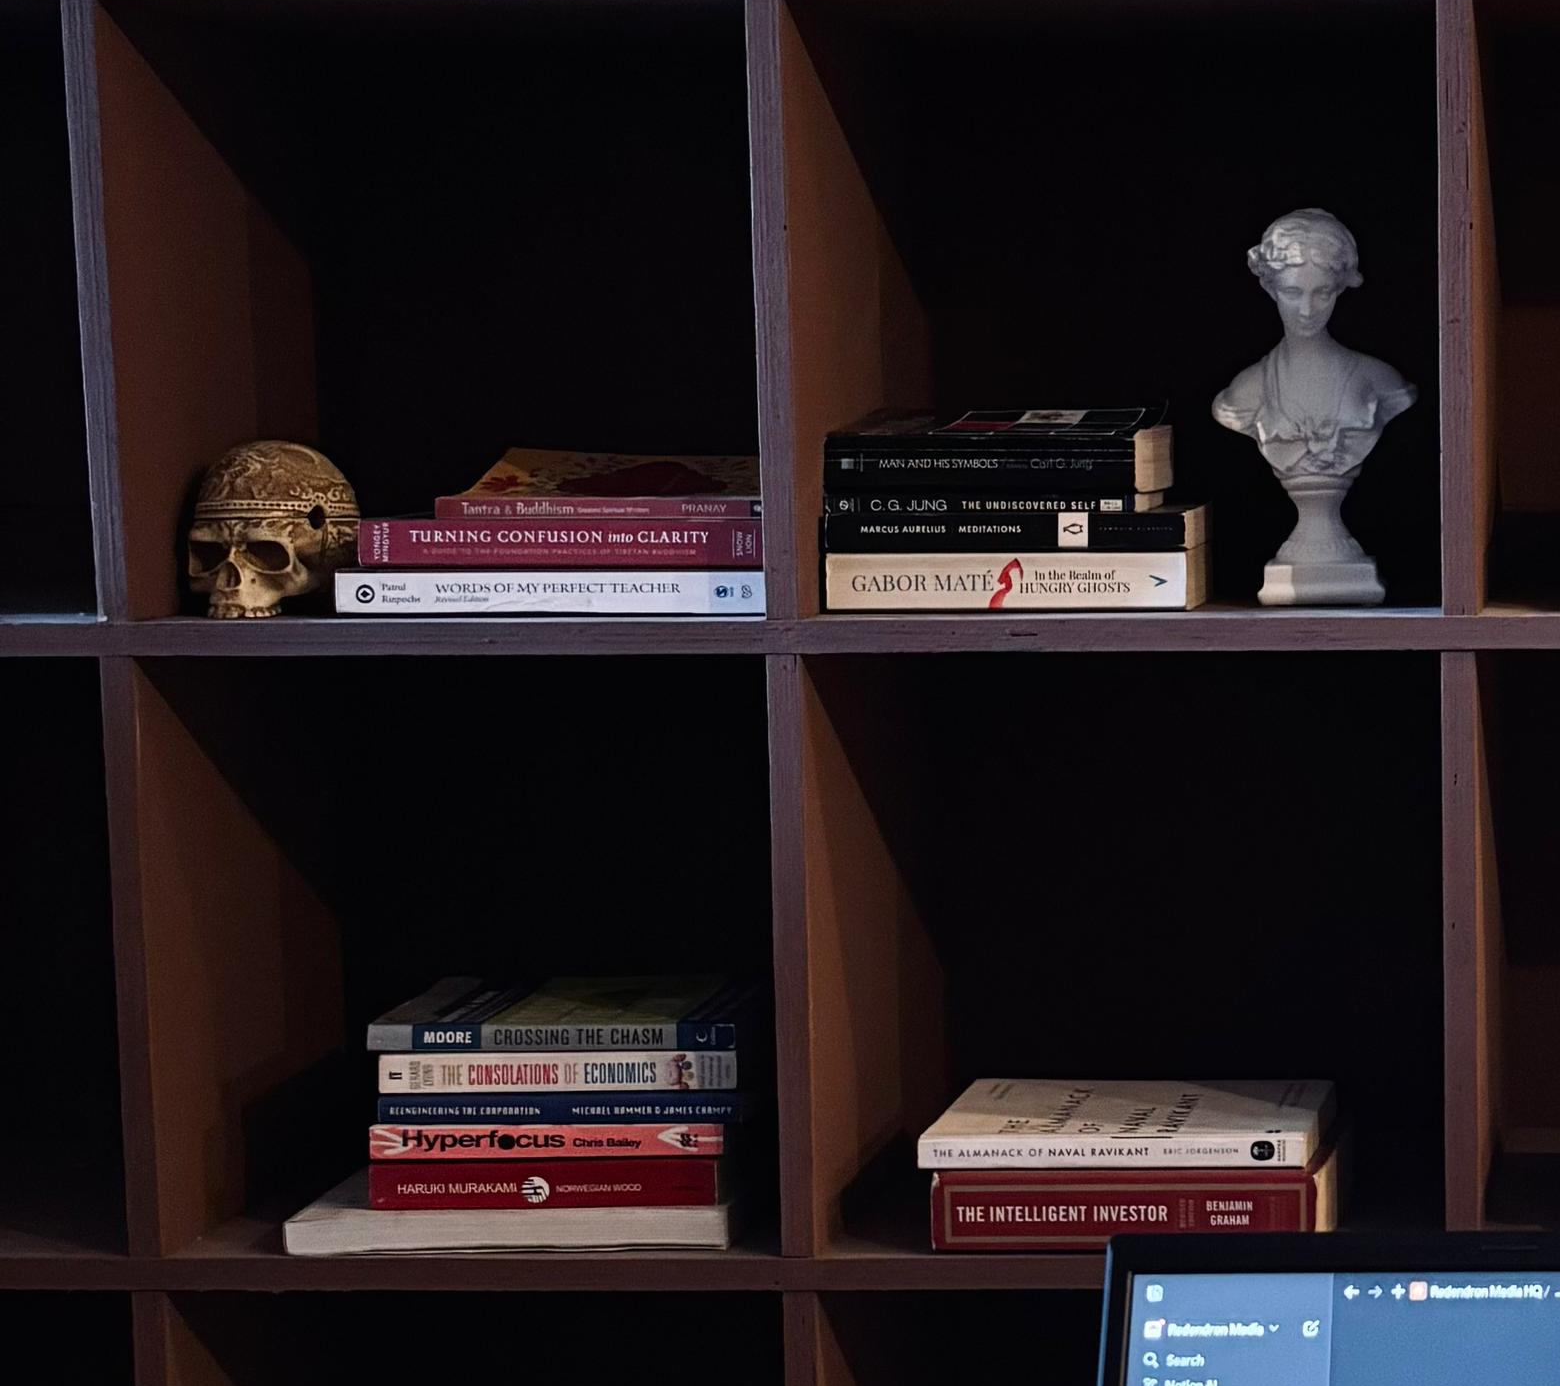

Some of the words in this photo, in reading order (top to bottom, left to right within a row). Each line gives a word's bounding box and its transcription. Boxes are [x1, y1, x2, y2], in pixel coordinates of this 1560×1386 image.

[462, 502, 500, 515] Tantra
[516, 502, 573, 515] Buddhism
[871, 499, 901, 512] C.G.
[906, 499, 947, 511] JUNG
[861, 525, 899, 533] MARCUS
[902, 525, 946, 533] AURELIUS
[959, 525, 1021, 533] MEDITATIONS
[410, 531, 492, 543] TURNING
[497, 531, 603, 543] CONFUSION
[608, 531, 633, 543] into
[638, 531, 709, 543] CLARITY
[852, 574, 926, 592] GABOR
[934, 571, 994, 591] MATÉ
[1020, 583, 1074, 595] HUNGRY
[1077, 582, 1130, 594] GHOSTS
[424, 1031, 472, 1043] MOORE
[494, 1029, 569, 1045] CROSSING
[576, 1029, 604, 1045] THE
[611, 1028, 663, 1045] CHASM
[442, 1065, 462, 1085] THE
[468, 1064, 558, 1085] CONSOLATIONS
[564, 1064, 581, 1084] OF
[584, 1063, 656, 1084] ECONOMICS
[401, 1130, 565, 1152] Hyperfocus
[1206, 1200, 1253, 1211] BENJAMIN
[957, 1206, 984, 1222] THE
[990, 1206, 1086, 1222] INTELLIGENT
[1094, 1205, 1168, 1221] INVESTOR
[1210, 1215, 1250, 1225] GRAHAM
[1166, 1354, 1205, 1367] Search
